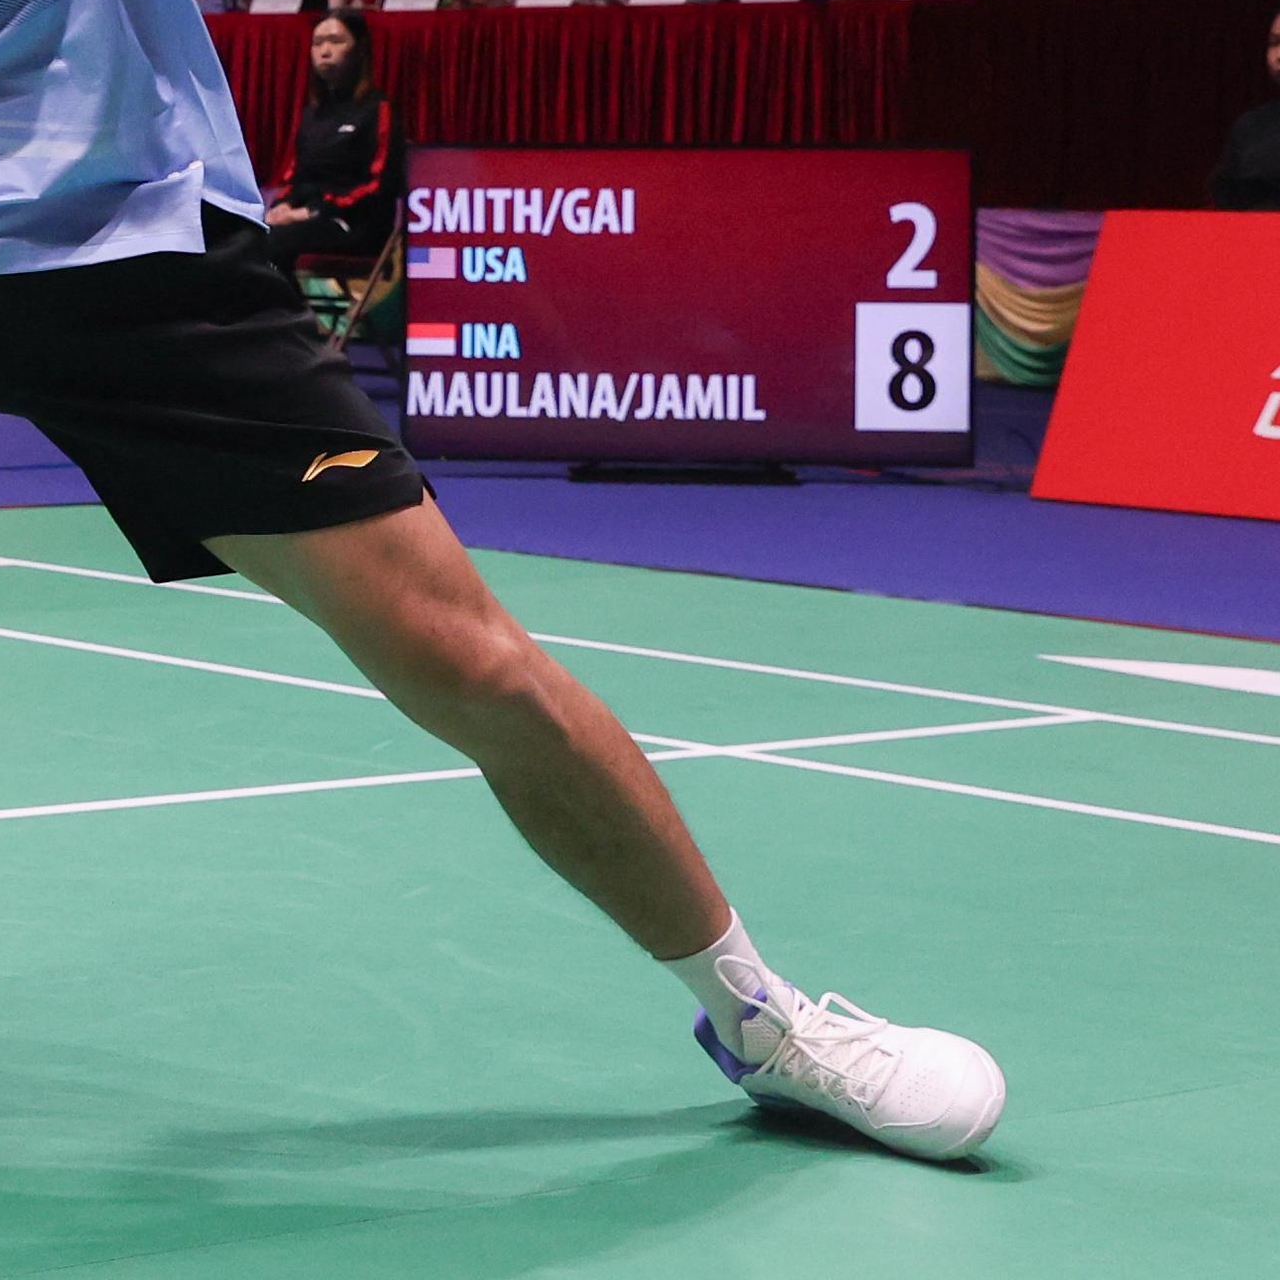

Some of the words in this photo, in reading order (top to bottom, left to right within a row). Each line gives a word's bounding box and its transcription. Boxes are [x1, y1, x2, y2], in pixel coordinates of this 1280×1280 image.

[407, 187, 636, 236] SMITH/GAI
[462, 246, 527, 283] USA
[886, 201, 937, 289] 2
[462, 322, 520, 359] INA
[889, 330, 936, 411] 8
[406, 372, 767, 421] MAULANA/JAMIL
